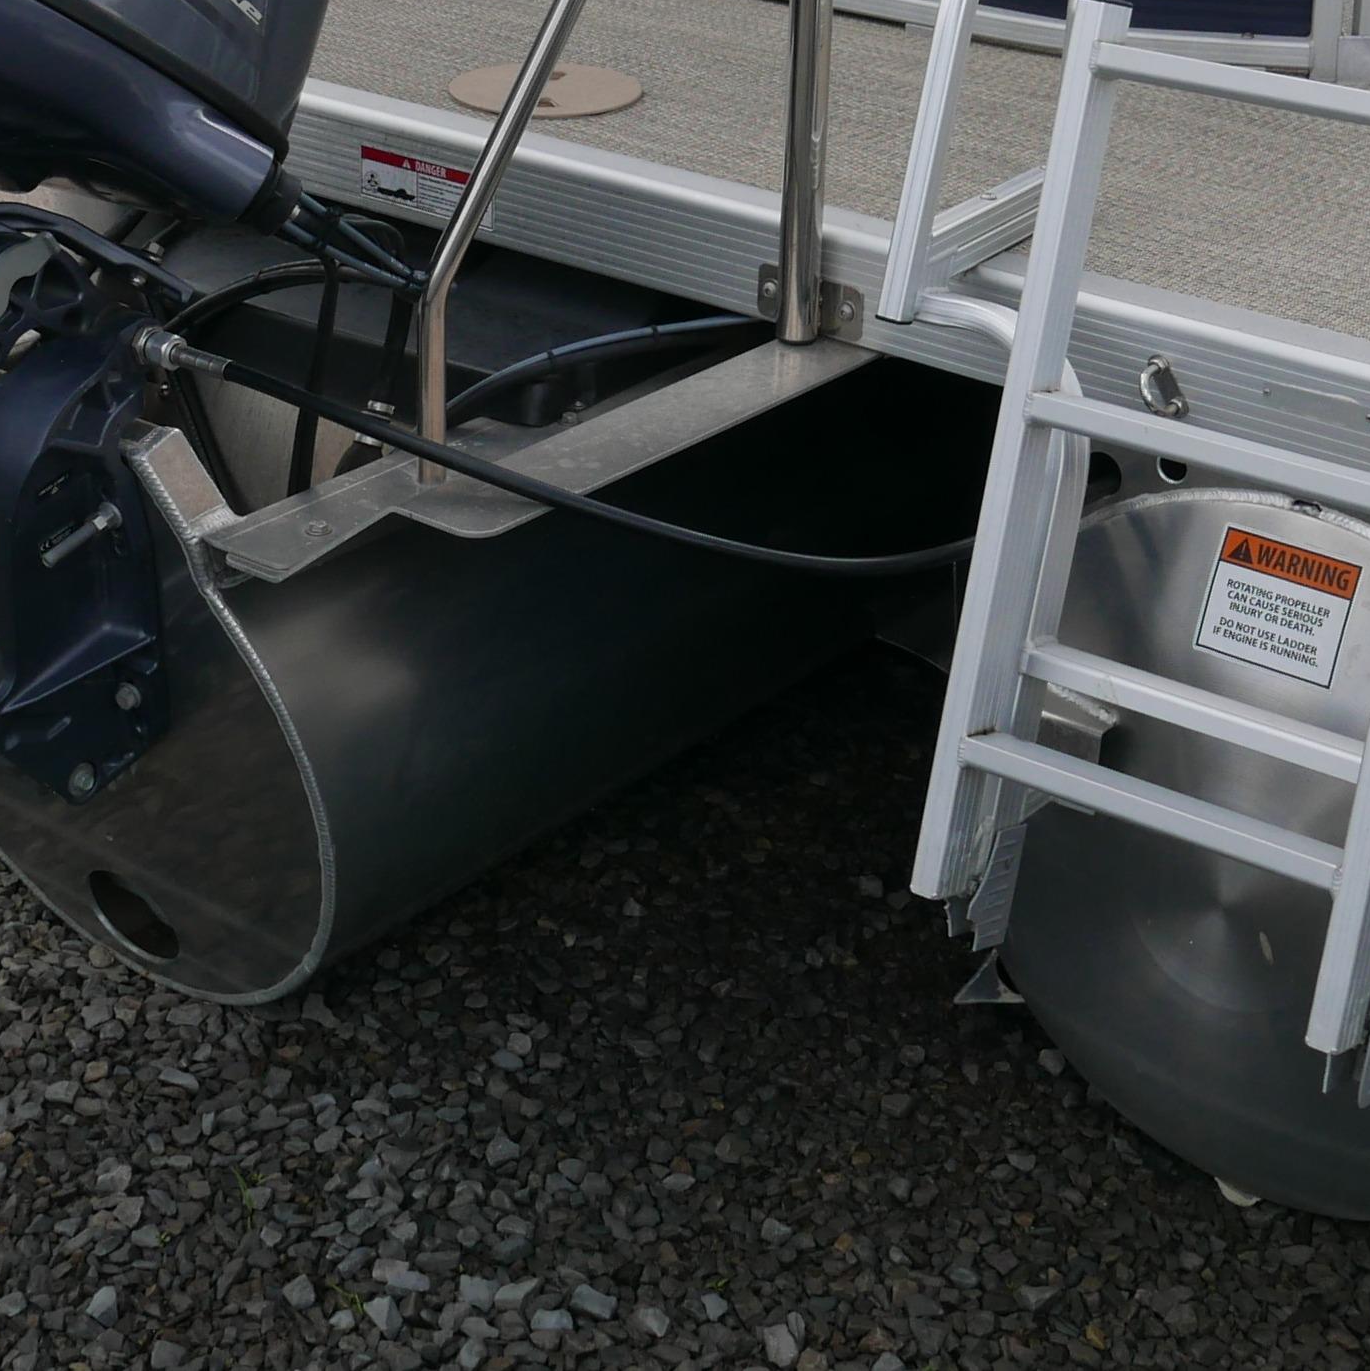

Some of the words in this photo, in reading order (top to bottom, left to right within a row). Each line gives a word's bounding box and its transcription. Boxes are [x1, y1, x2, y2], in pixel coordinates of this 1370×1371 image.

[414, 161, 447, 179] DANGER
[1256, 543, 1352, 592] WARNING
[1226, 578, 1273, 601] ROTATING
[1275, 593, 1331, 618] PROPELLER
[1227, 590, 1248, 603] CAN
[1249, 596, 1282, 614] CAUSE
[1282, 606, 1324, 628] SERIOUS
[1219, 616, 1234, 628] DO
[1235, 621, 1255, 636] NOT
[1257, 628, 1277, 642] USE
[1277, 634, 1318, 656] LADDER
[1229, 601, 1263, 620] INJURY
[1264, 612, 1279, 625] OR
[1279, 617, 1315, 637] DEATH.
[1212, 625, 1222, 636] IF
[1223, 628, 1259, 648] ENGINE
[1259, 640, 1269, 651] IS
[1269, 644, 1318, 668] RUNNING.
